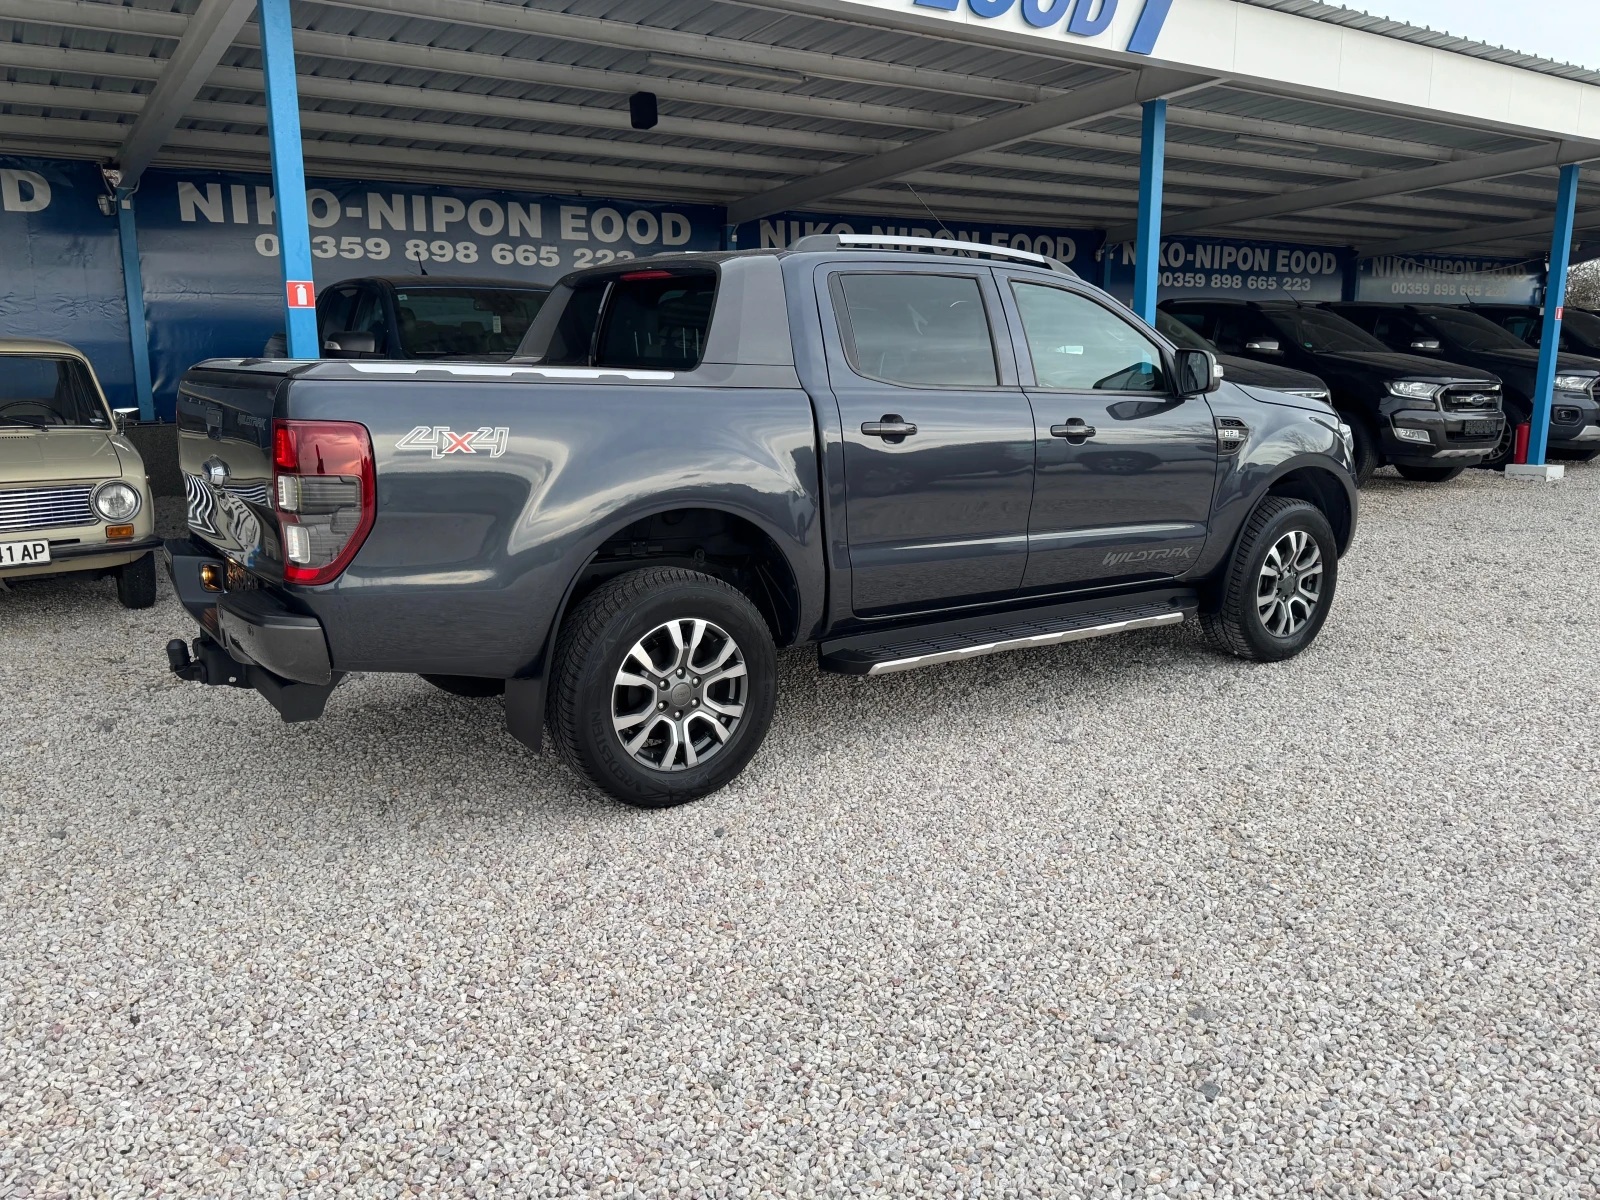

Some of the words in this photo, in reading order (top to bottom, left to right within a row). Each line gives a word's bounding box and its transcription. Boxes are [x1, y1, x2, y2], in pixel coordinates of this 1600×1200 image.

[177, 181, 542, 239] NIKO-NIPON
[559, 204, 692, 246] EOOD
[255, 233, 391, 261] 0359
[404, 239, 479, 264] 898
[491, 243, 561, 268] 665
[991, 232, 1077, 264] EOOD
[1122, 241, 1270, 272] NKO-NIPON
[1276, 249, 1337, 275] EOOD
[1157, 271, 1206, 288] 0359
[1210, 273, 1243, 290] 898
[1247, 275, 1277, 291] 665
[1282, 277, 1311, 292] 223
[1372, 256, 1478, 281] NIKO-NIPON
[1481, 262, 1527, 283] EOOD
[1391, 281, 1430, 296] 00359
[1433, 283, 1457, 297] 898
[1459, 284, 1482, 298] 665
[20, 543, 46, 562] AP
[1102, 545, 1195, 567] WILDTRAK
